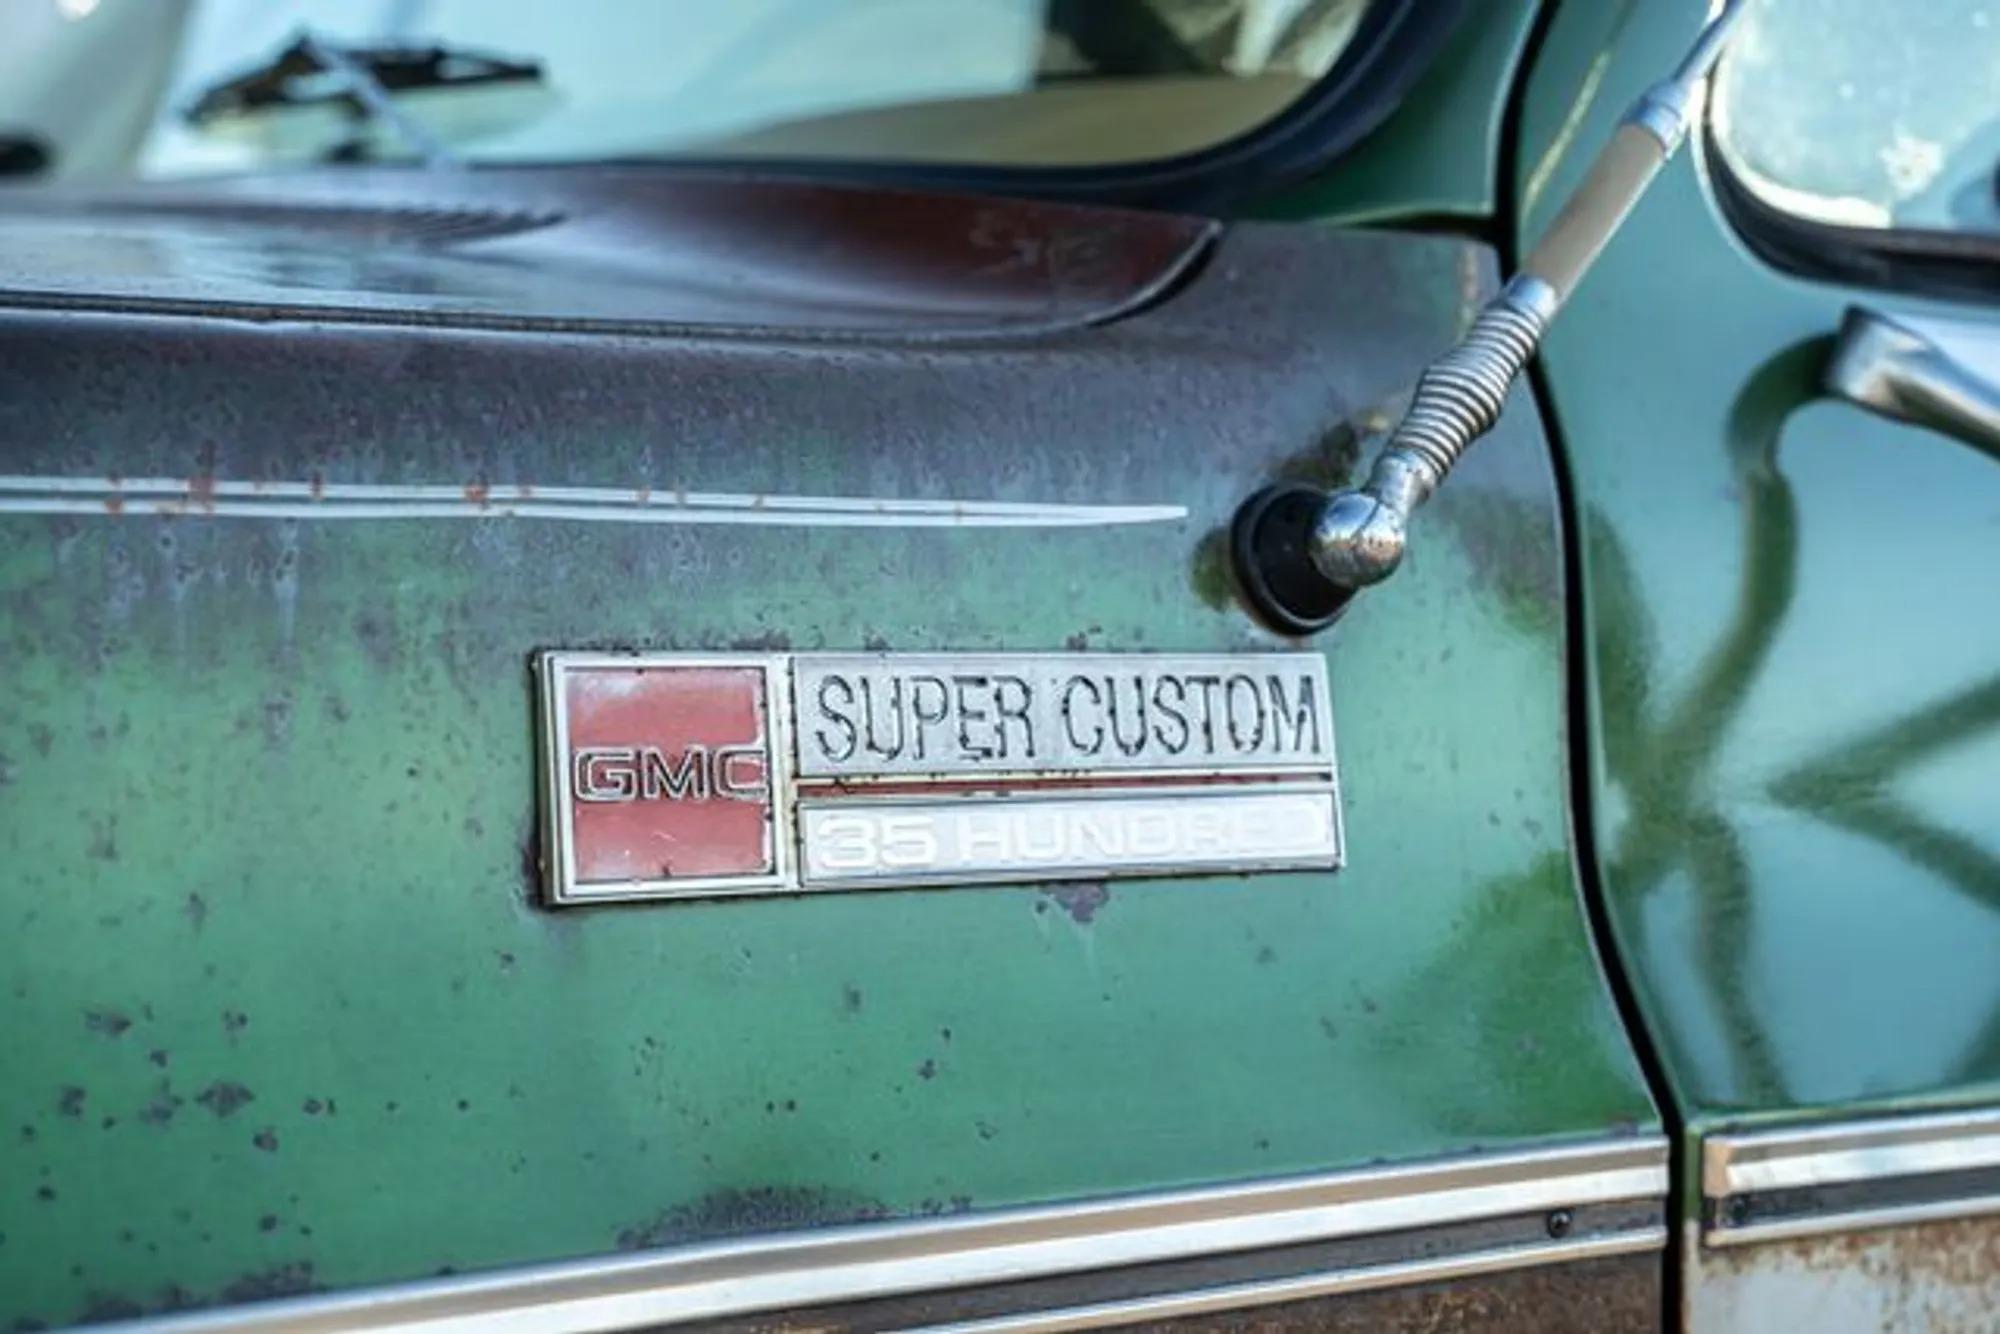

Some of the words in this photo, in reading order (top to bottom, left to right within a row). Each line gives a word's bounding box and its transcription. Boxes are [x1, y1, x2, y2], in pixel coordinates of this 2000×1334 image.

[814, 673, 1036, 762] SUPER
[1061, 673, 1322, 757] CUSTOM
[573, 744, 771, 801] GMC
[816, 815, 938, 869] 35
